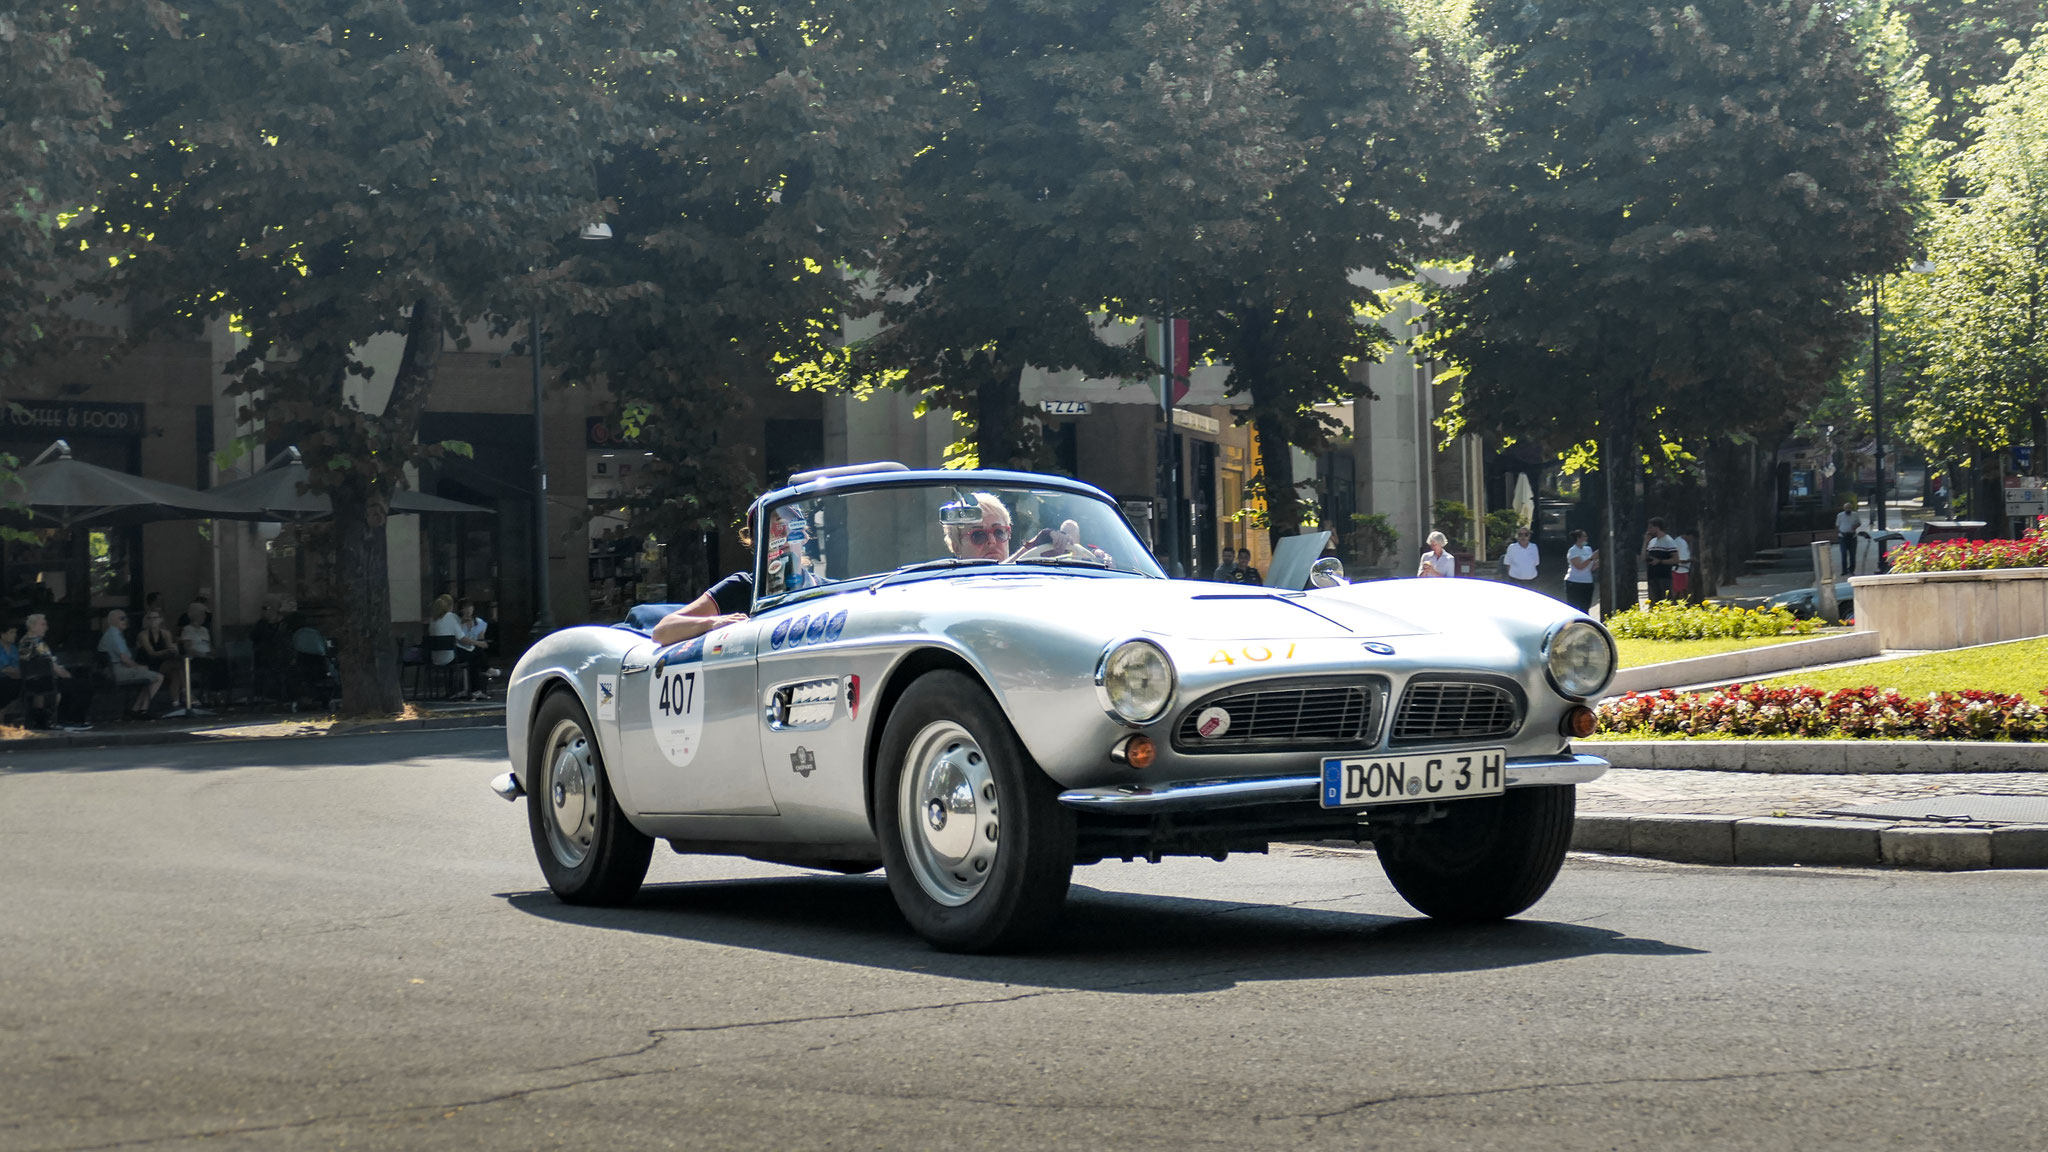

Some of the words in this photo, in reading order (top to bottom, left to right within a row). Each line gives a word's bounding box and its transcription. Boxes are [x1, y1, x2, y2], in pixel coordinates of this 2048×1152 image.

[83, 410, 129, 429] FOOD
[659, 672, 695, 716] 407
[1329, 788, 1336, 797] D
[1346, 762, 1404, 798] DON
